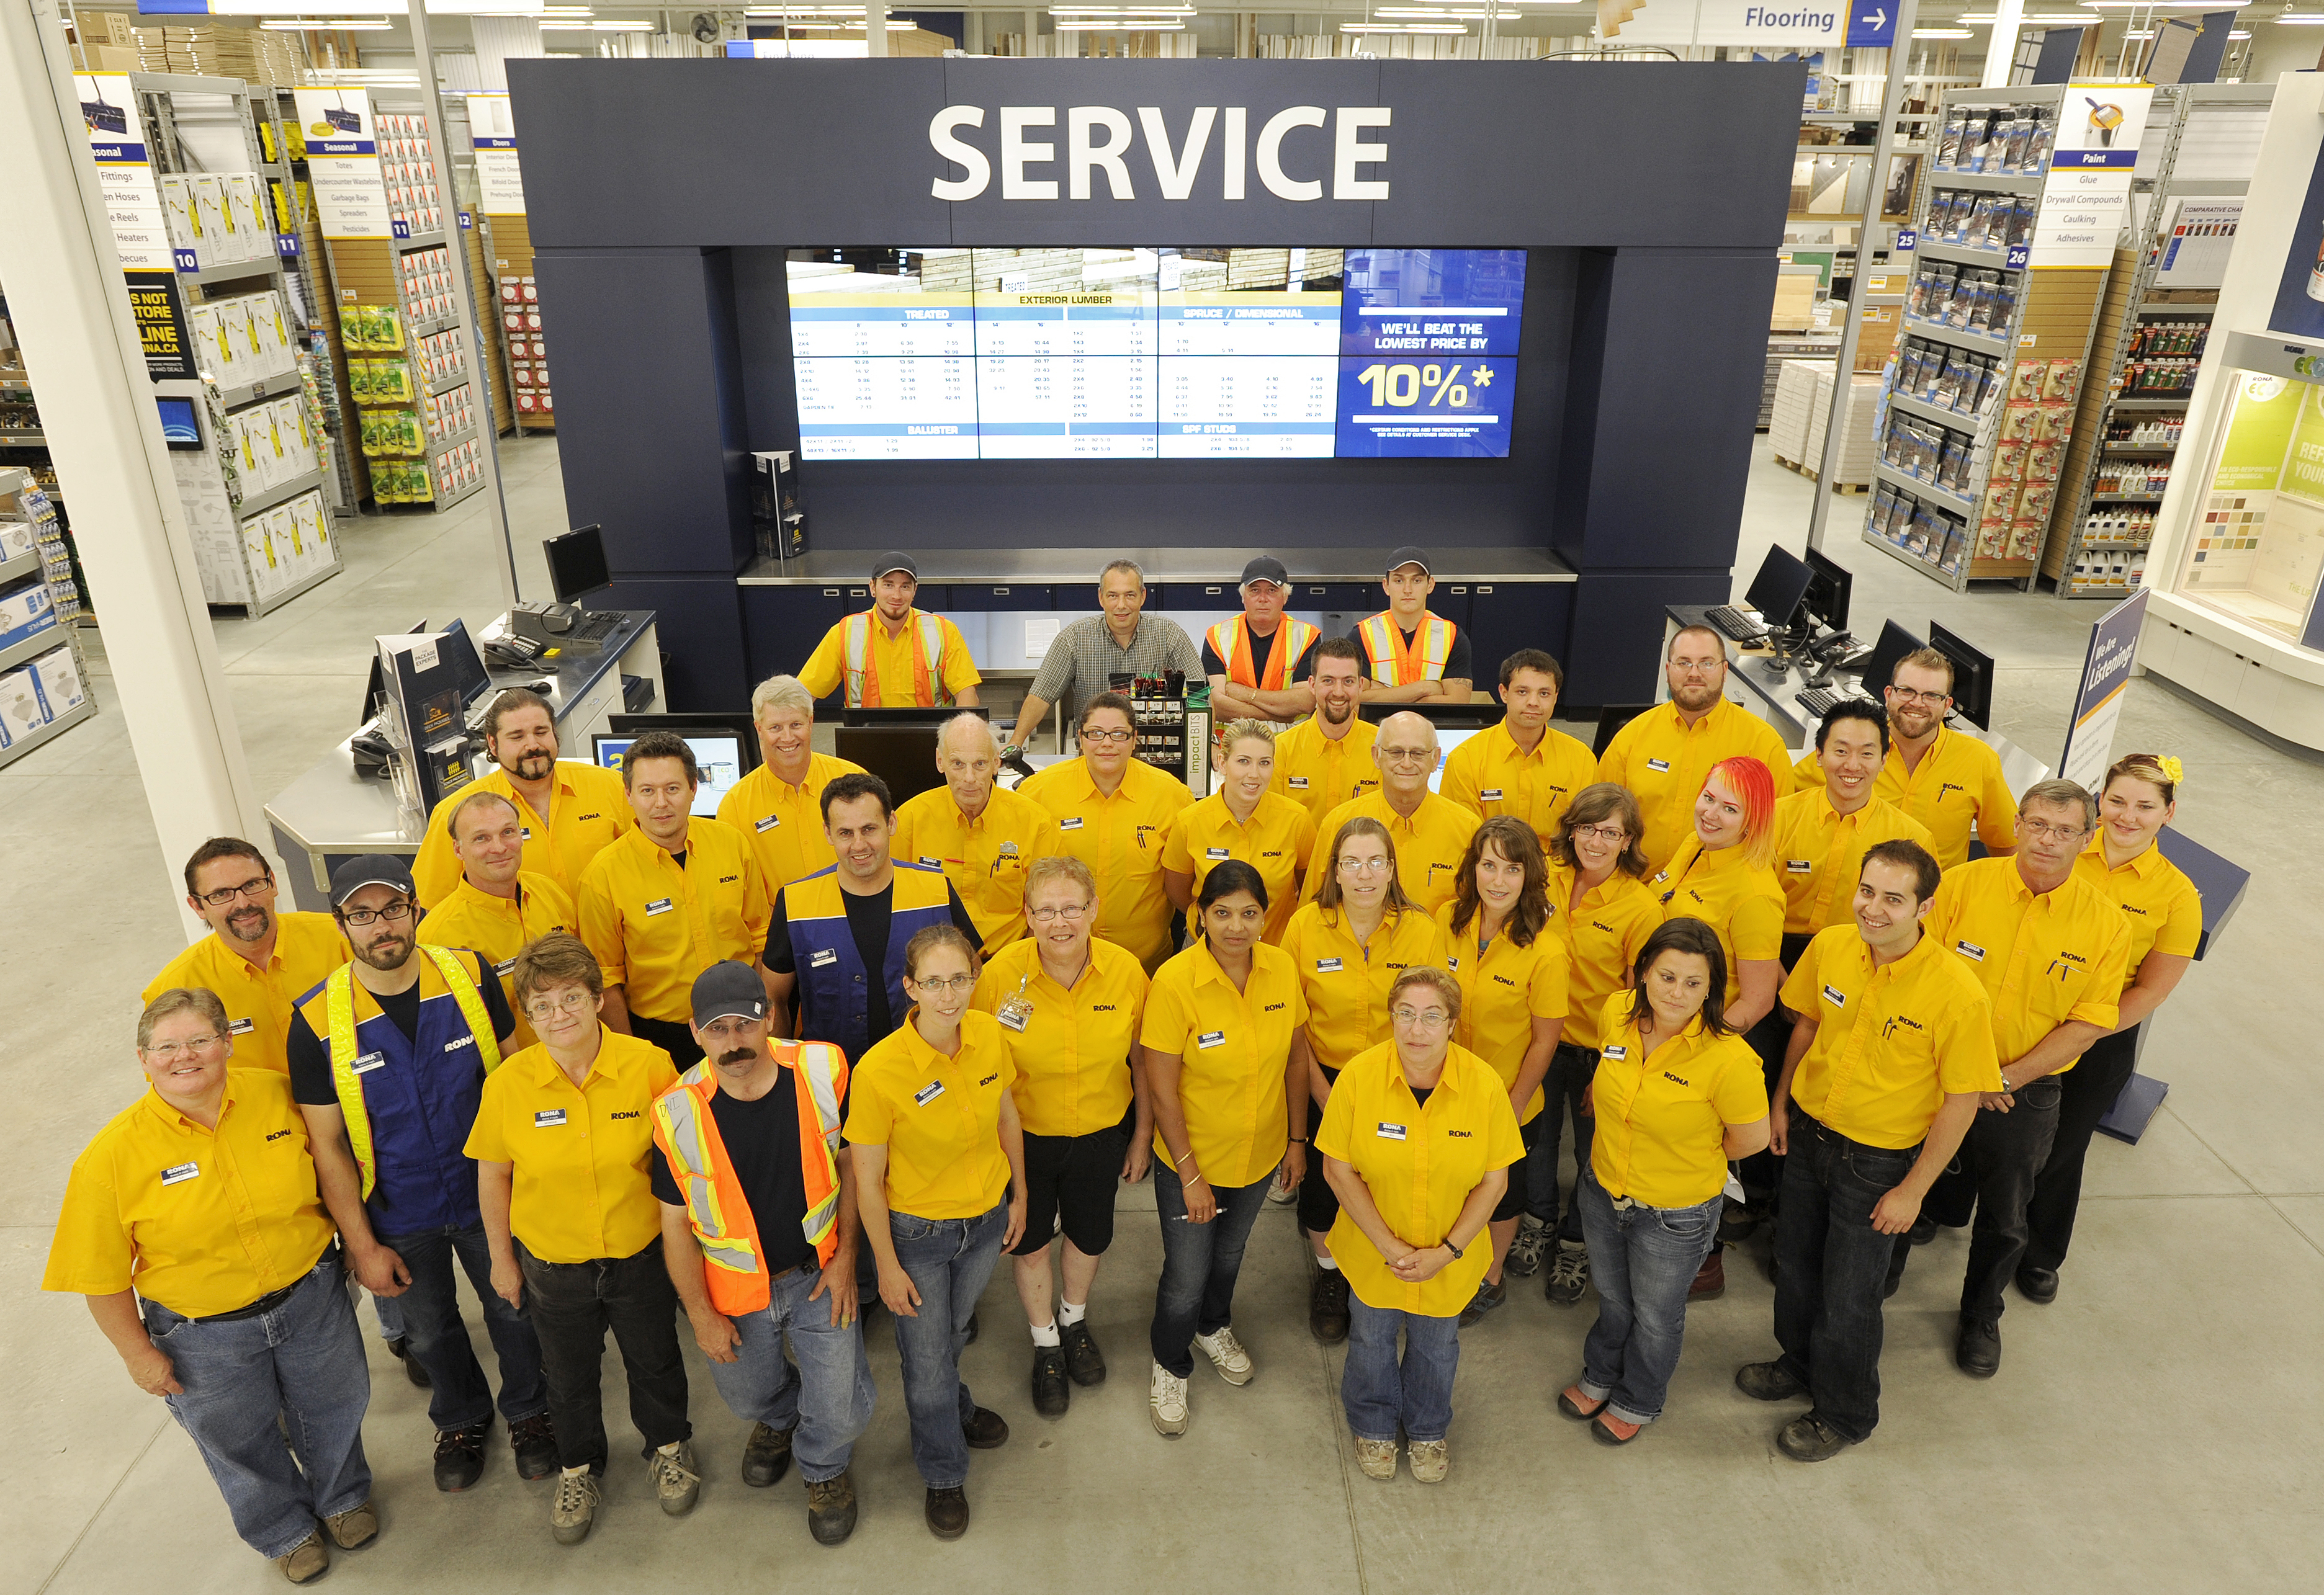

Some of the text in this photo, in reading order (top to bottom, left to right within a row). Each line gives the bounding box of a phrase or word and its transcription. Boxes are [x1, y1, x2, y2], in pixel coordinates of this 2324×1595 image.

[1745, 7, 1835, 32] Flooring
[324, 142, 357, 153] Seasonal
[928, 104, 1393, 202] SERVICE
[2082, 153, 2107, 164] Paint
[101, 171, 133, 183] Fittings
[2079, 175, 2097, 184] Glue
[115, 192, 140, 201] Hoses
[331, 194, 369, 203] Garbage Bags
[2045, 194, 2123, 205] Drywall Compounds
[117, 213, 139, 221] Reels
[339, 209, 367, 218] Spreaders
[2062, 213, 2096, 225] Caulking
[459, 215, 470, 226] 12
[342, 224, 370, 232] Pesticides
[394, 224, 407, 235] 11
[117, 233, 149, 241] Heaters
[1898, 235, 1914, 246] 25
[2056, 233, 2094, 243] Adhesives
[279, 239, 295, 251] 11
[176, 254, 195, 267] 10
[2008, 251, 2027, 264] 26
[142, 293, 168, 304] NOT
[1020, 296, 1112, 304] EXTERIOR LUMBER
[904, 310, 949, 319] TREATED
[1183, 308, 1223, 318] SPRUCE
[1234, 308, 1304, 318] DIMENSIONAL
[1381, 323, 1483, 334] WE'LL BEAT THE
[140, 327, 178, 342] LINE
[1375, 337, 1488, 349] LOWEST PRICE BY
[2283, 344, 2306, 355] RONA
[907, 426, 959, 435] BALUSTER
[1182, 424, 1237, 434] SPF STUDS
[2095, 637, 2117, 661] We Are
[415, 650, 436, 661] PACKAGE
[2087, 635, 2136, 692] Listening!
[1549, 785, 1569, 793] RONA
[1942, 782, 1965, 792] RONA
[578, 812, 601, 821] RONA
[758, 816, 773, 825] RONA
[998, 853, 1020, 861] RONA
[1431, 862, 1454, 870] RONA
[719, 874, 739, 883] RONA
[1689, 889, 1704, 905] RONA
[649, 899, 666, 908] RONA
[2121, 903, 2147, 916] RONA
[1592, 920, 1614, 934] RONA
[1963, 942, 1980, 953] RONA
[814, 950, 830, 958] RONA
[2060, 950, 2087, 964] RONA
[1492, 974, 1515, 986] RONA
[1093, 1003, 1117, 1012] RONA
[1264, 1001, 1286, 1012] RONA
[1898, 1014, 1923, 1031] RONA
[1202, 1032, 1220, 1040] RONA
[444, 1034, 476, 1053] RONA
[354, 1054, 377, 1065] RONA
[979, 1071, 999, 1088] RONA
[1663, 1071, 1690, 1088] RONA
[918, 1083, 937, 1097] RONA
[539, 1110, 560, 1118] RONA
[611, 1110, 640, 1121] RONA
[1383, 1123, 1401, 1131] RONA
[266, 1128, 292, 1142] RONA
[1448, 1130, 1473, 1138] RONA
[166, 1164, 191, 1176] RONA
